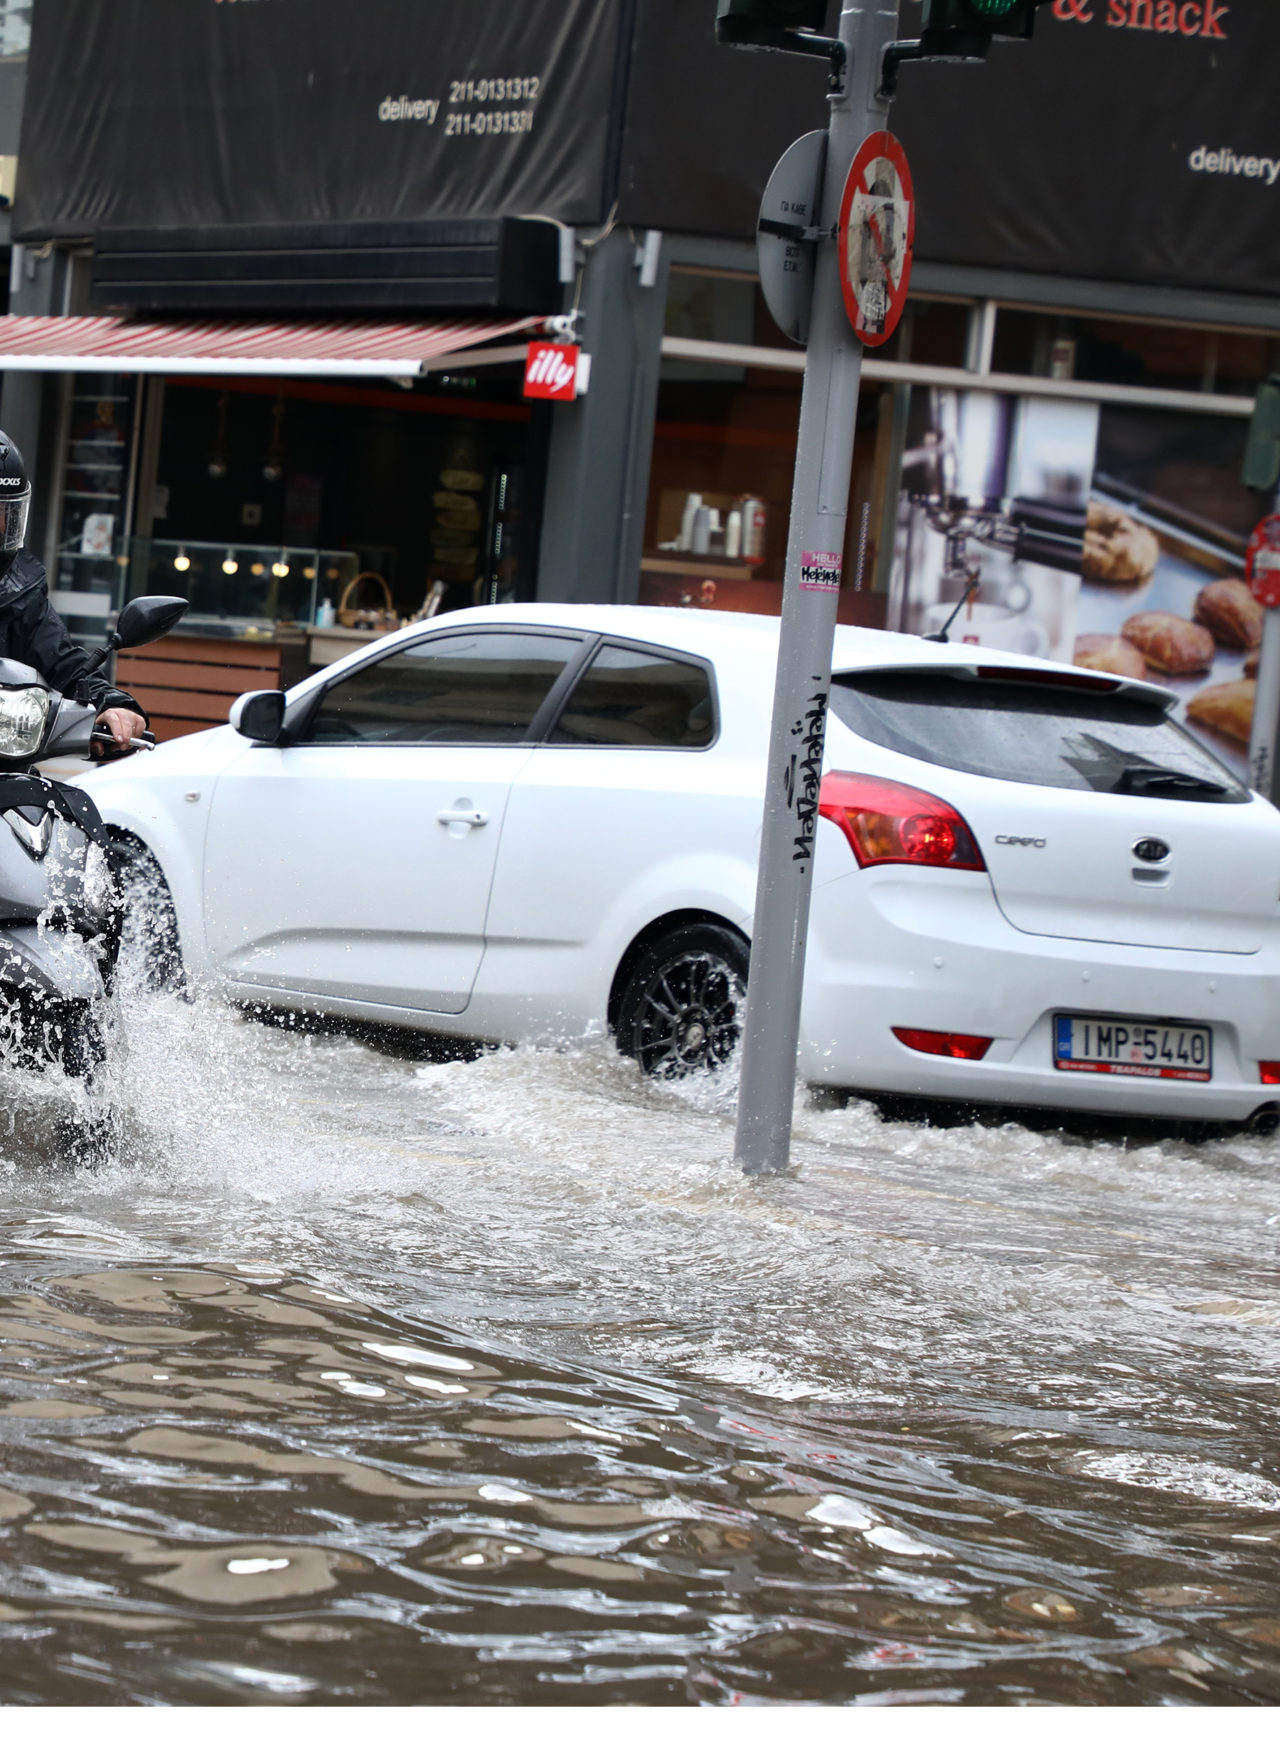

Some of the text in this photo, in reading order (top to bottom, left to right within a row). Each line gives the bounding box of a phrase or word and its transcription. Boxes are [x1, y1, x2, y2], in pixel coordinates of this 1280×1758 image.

[378, 95, 440, 125] delivery
[1189, 145, 1280, 185] delivery
[527, 349, 575, 393] illy
